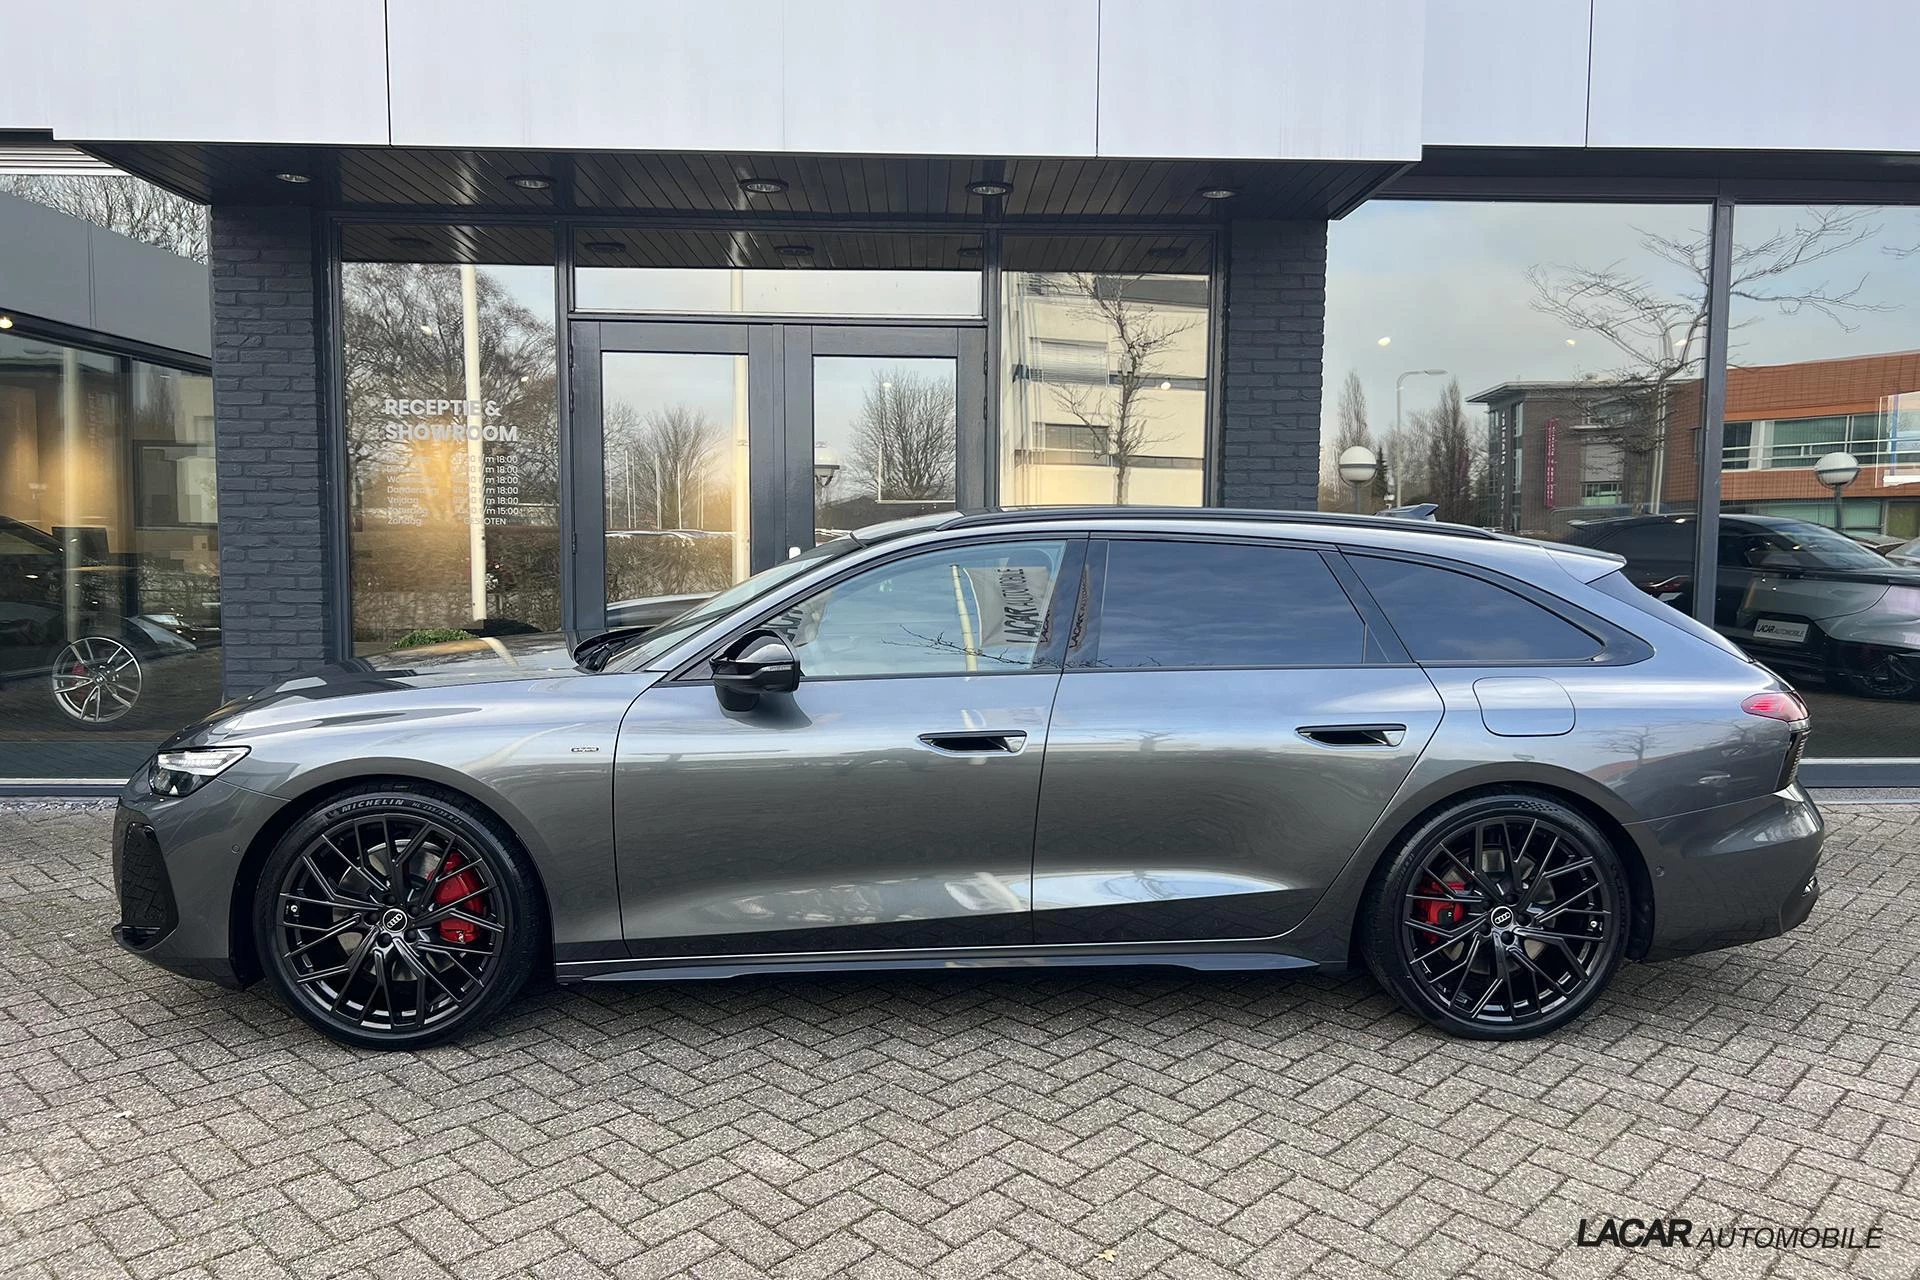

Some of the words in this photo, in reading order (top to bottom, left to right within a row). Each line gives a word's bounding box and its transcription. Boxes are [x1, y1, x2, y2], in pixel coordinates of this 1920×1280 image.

[385, 399, 480, 416] RECEPTIE
[484, 400, 501, 416] &
[385, 421, 518, 441] SHOWROOM
[496, 455, 518, 463] 18:00
[496, 465, 518, 474] 18:00
[496, 476, 518, 484] 18:00
[496, 486, 519, 494] 18:00
[496, 497, 519, 505] 18:00
[496, 507, 519, 515] 15:00
[387, 517, 421, 527] Zondag
[1003, 606, 1042, 644] LACAR
[341, 799, 404, 813] MICHELIN
